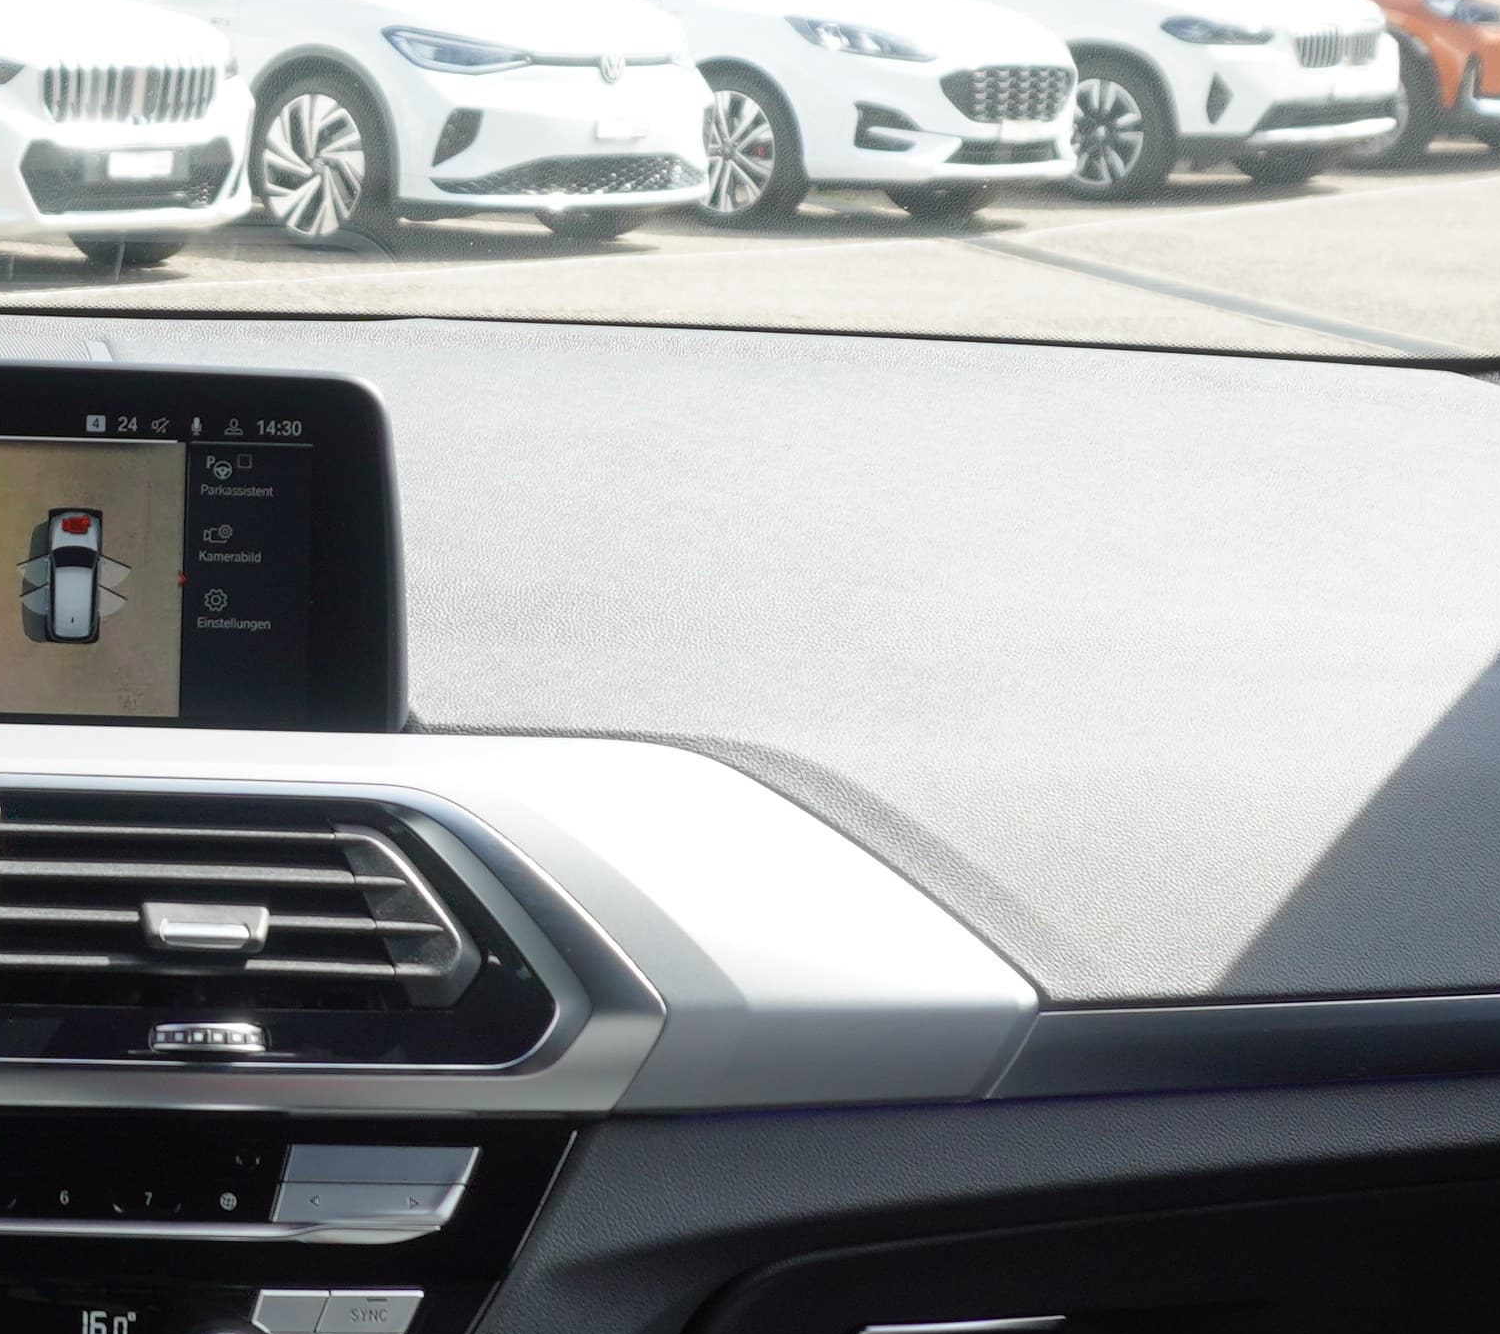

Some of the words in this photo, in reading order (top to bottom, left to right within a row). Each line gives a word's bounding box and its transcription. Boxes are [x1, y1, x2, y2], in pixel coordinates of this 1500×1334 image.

[117, 416, 139, 432] 24
[257, 420, 303, 436] 14:30
[200, 483, 274, 498] Parkassistent
[199, 550, 262, 564] Kamerabild
[197, 618, 272, 632] Einstellungen
[60, 1189, 70, 1205] 6
[144, 1191, 153, 1206] 7
[350, 1308, 388, 1323] SYNC
